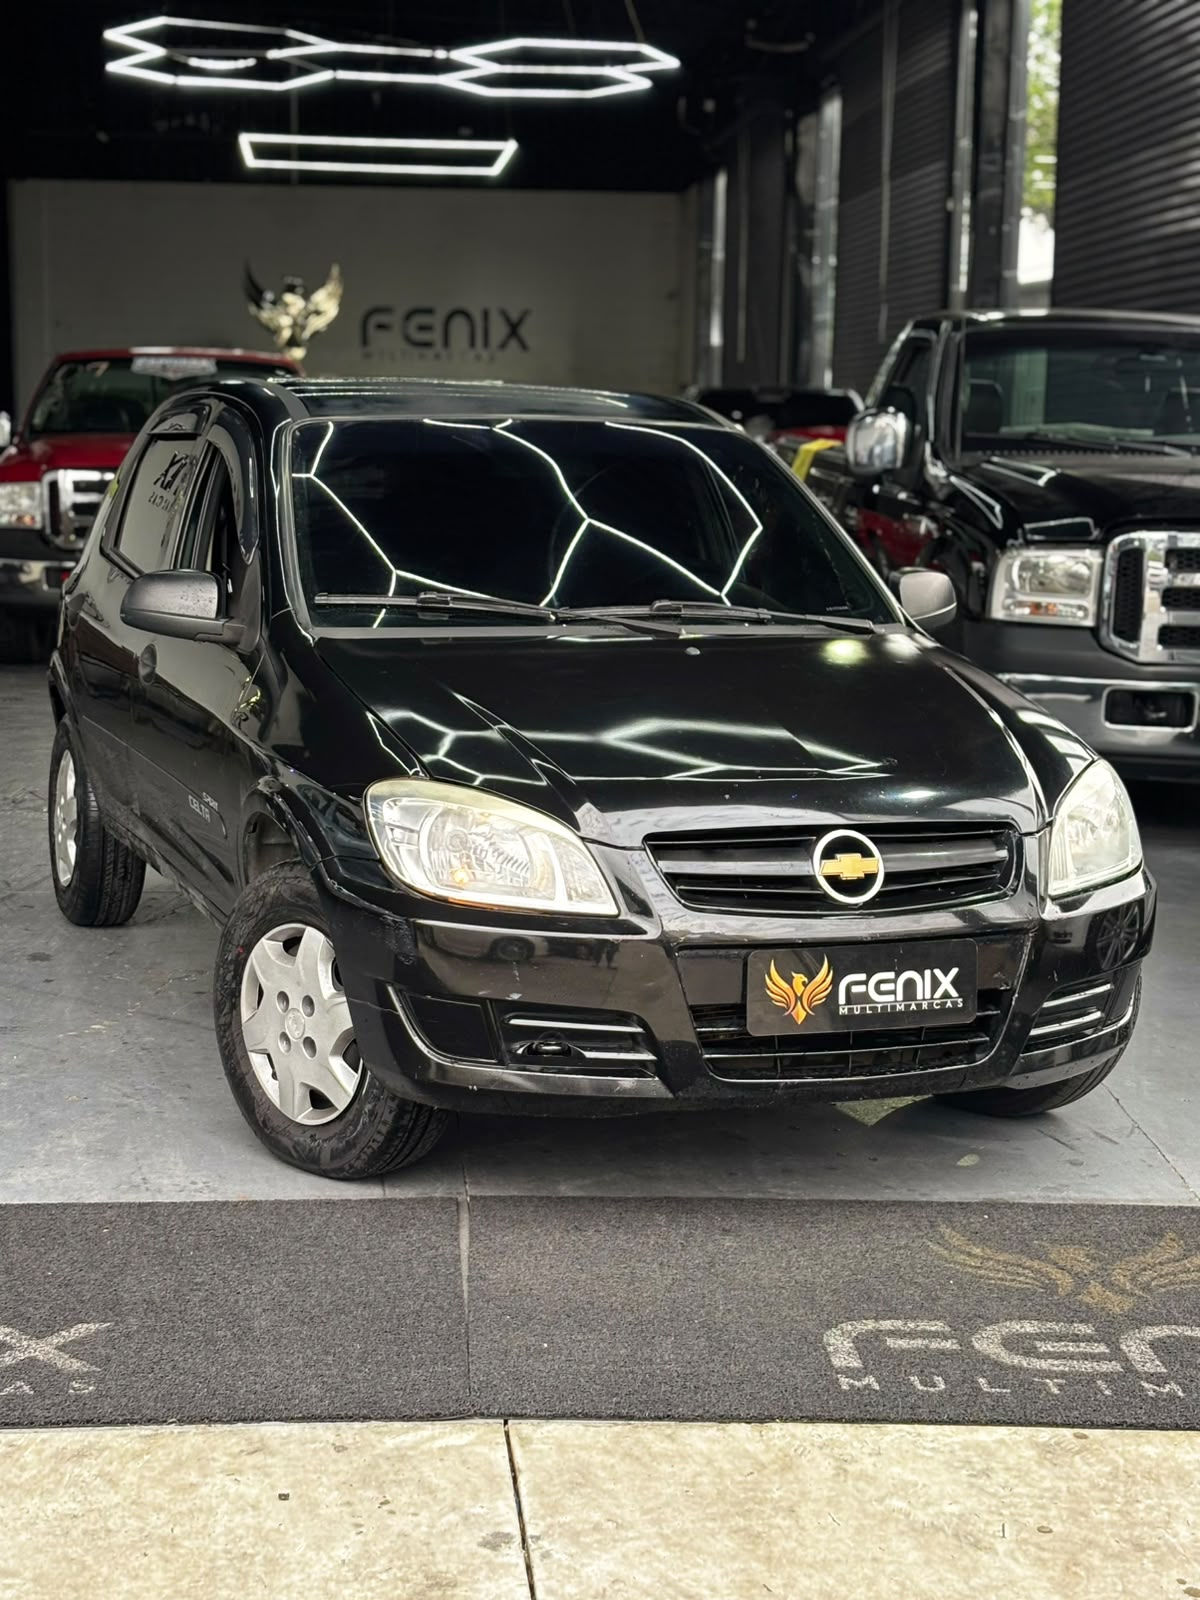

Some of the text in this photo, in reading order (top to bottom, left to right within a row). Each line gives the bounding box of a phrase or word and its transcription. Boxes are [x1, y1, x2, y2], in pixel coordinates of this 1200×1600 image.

[361, 306, 533, 352] FENIX
[838, 967, 960, 1005] FENIX
[839, 998, 964, 1016] MULTIMARCAS
